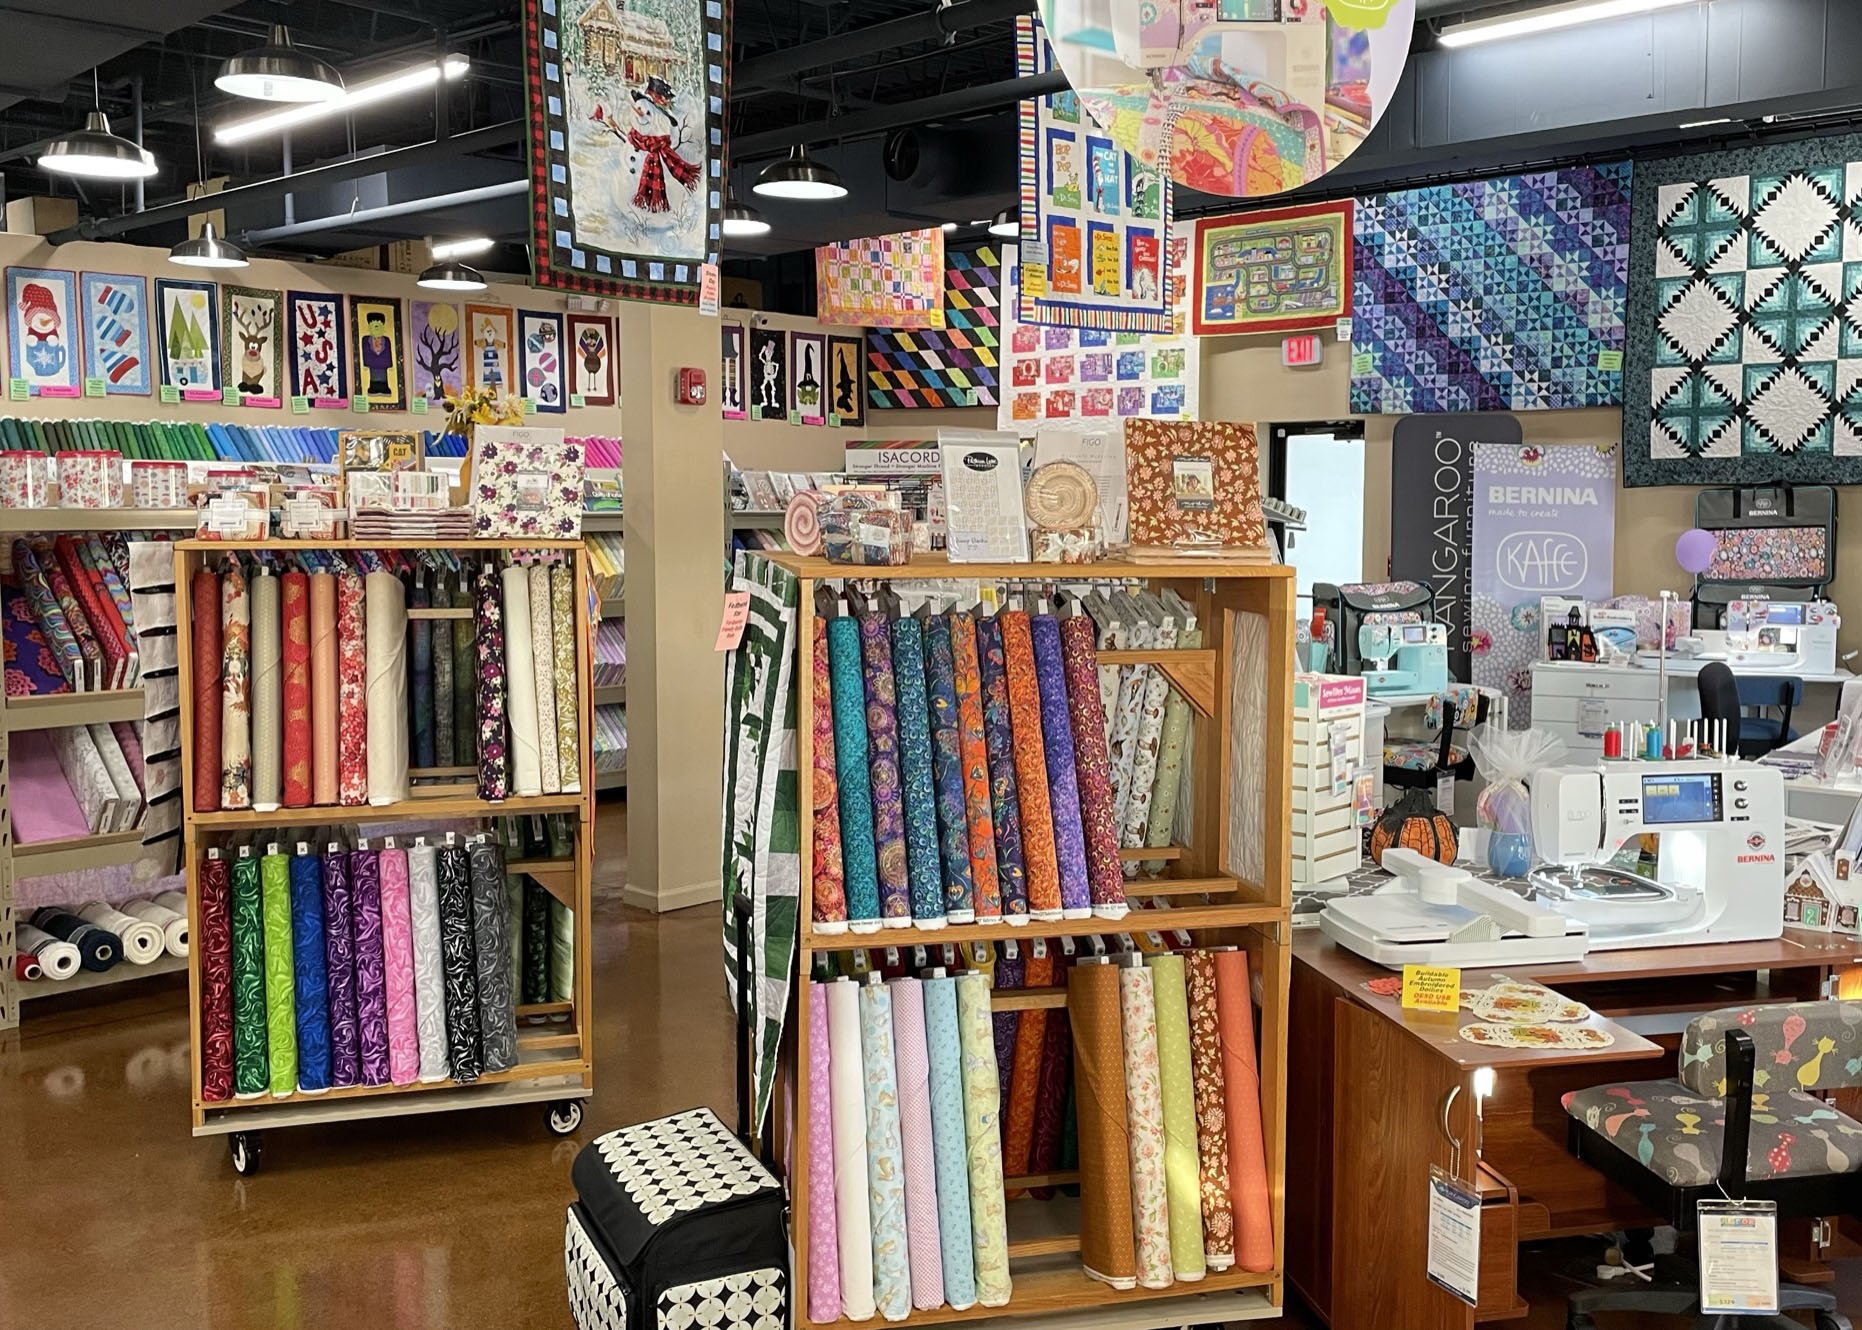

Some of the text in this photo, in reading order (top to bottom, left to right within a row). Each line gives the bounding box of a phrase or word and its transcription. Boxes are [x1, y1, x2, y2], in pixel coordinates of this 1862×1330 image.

[1104, 152, 1117, 161] CAT
[1105, 175, 1118, 184] HAT
[1288, 335, 1314, 363] EXIT
[1081, 438, 1102, 447] FIGO
[393, 447, 406, 457] CAT
[878, 451, 941, 464] ISACORD
[1489, 486, 1598, 505] BERNINA
[1488, 508, 1559, 518] made to create
[1737, 854, 1776, 863] BERNINA
[1409, 980, 1456, 989] Embroidered
